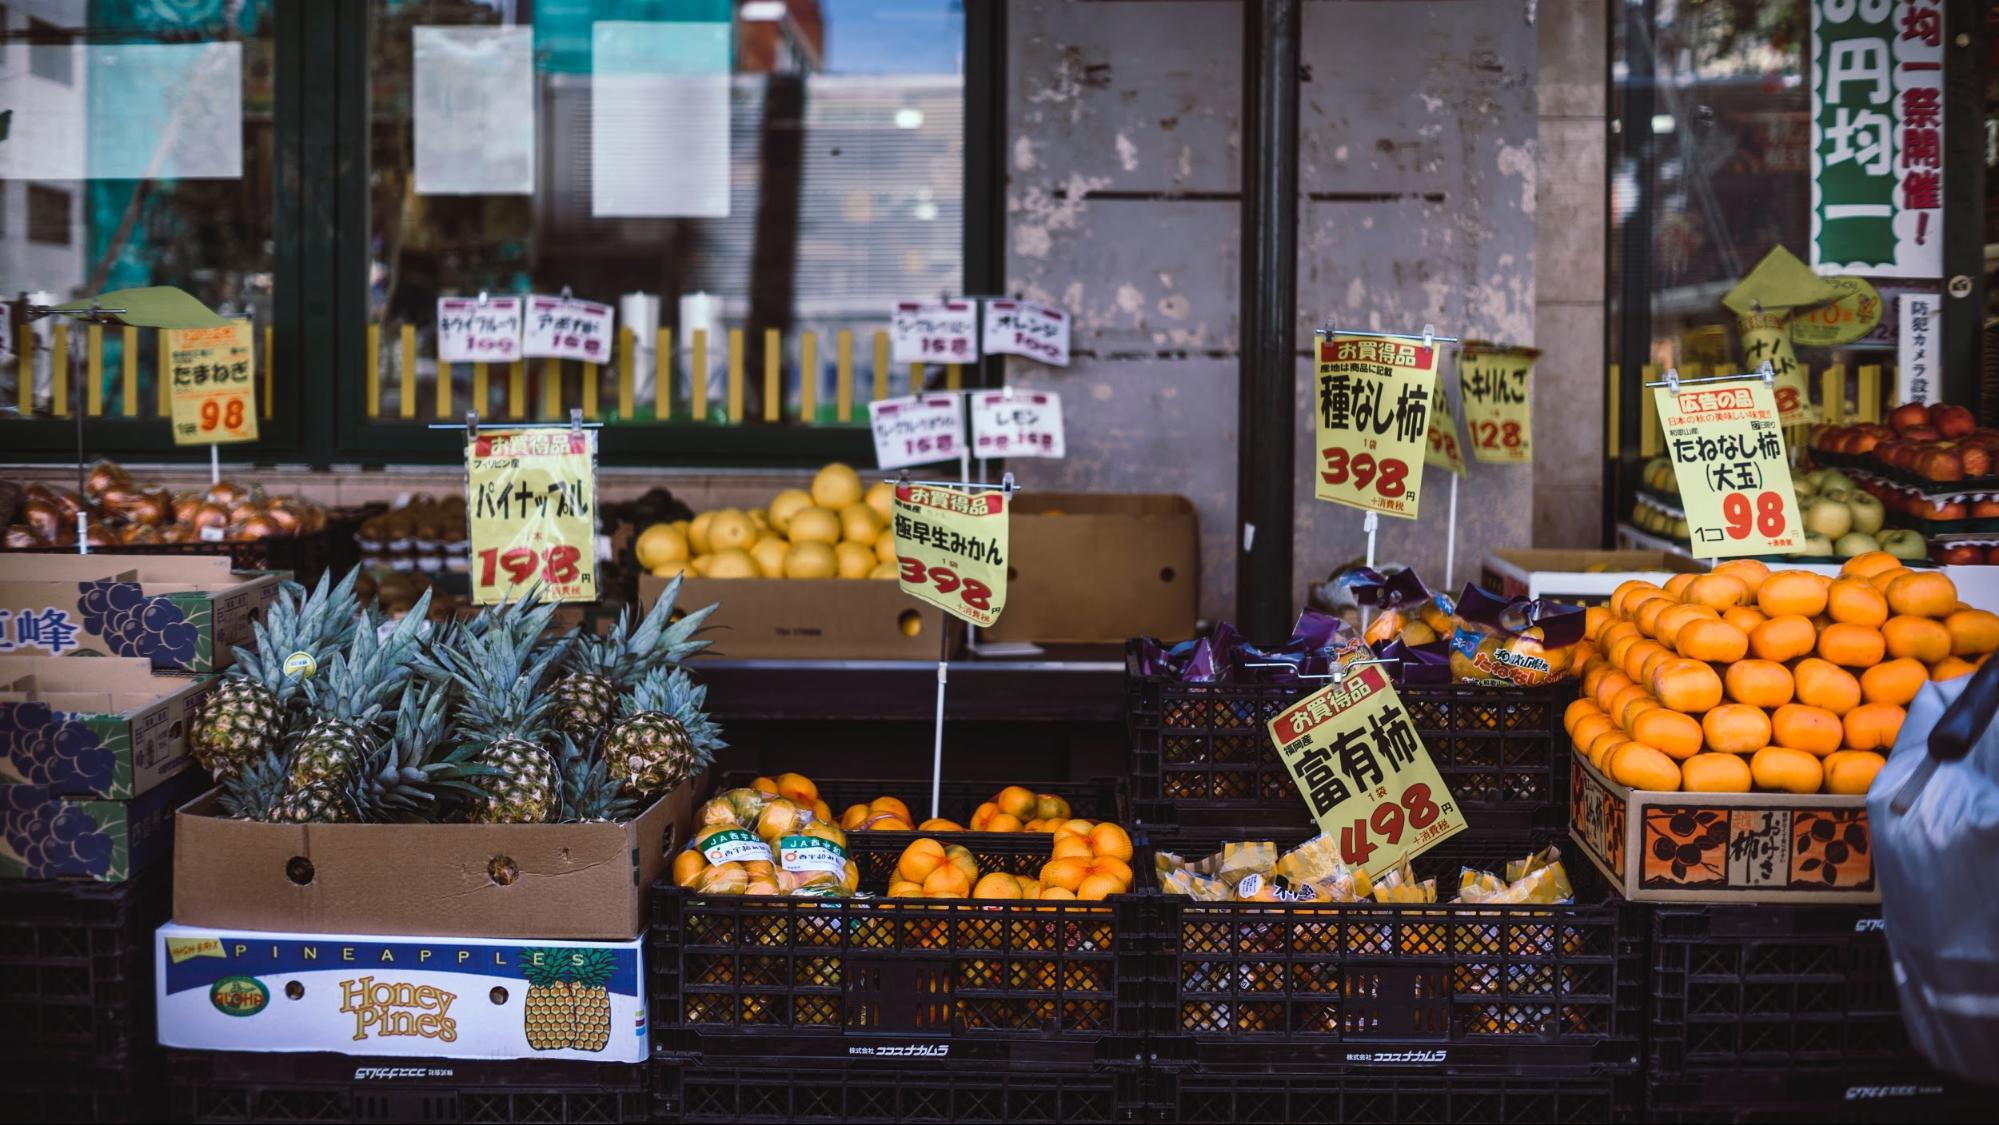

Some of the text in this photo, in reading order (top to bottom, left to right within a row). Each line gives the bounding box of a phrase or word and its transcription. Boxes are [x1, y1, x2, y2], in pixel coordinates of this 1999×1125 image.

[1902, 0, 1942, 246] 均一祭開催!
[1338, 341, 1416, 366] お買得品
[174, 362, 248, 385] たまねぎ
[1320, 364, 1393, 378] 産地は商品に記載
[1320, 374, 1428, 443] 種なし柿
[1680, 389, 1753, 412] 広告の品
[1774, 387, 1800, 413] 8
[201, 400, 244, 431] 98
[491, 436, 569, 454] お買得品
[1363, 438, 1377, 450] 1袋
[1469, 419, 1522, 449] 128
[1673, 432, 1781, 463] たねなし柿
[1320, 446, 1409, 498] 398
[1706, 462, 1762, 492] (大玉)
[476, 480, 588, 519] パイナップル
[910, 487, 988, 515] お買得品
[1406, 491, 1416, 501] 円
[1723, 491, 1786, 540] 98
[895, 513, 1003, 566] 極早生みかん
[478, 546, 581, 587] 198
[582, 574, 591, 583] 円
[897, 555, 992, 611] 398
[1290, 677, 1371, 734] お買得品
[1283, 733, 1314, 757] 福岡産
[1293, 704, 1418, 818] 富有柿
[1367, 786, 1388, 802] 1袋
[1441, 801, 1454, 815] 円
[1340, 782, 1440, 866] 498
[235, 944, 584, 966] PINEAPPLES
[339, 976, 457, 1020] Honey
[353, 1005, 457, 1042] Pines
[848, 1045, 950, 1056] 株式会社 ココスナカムラ
[1373, 1050, 1447, 1062] ココスナカムラ
